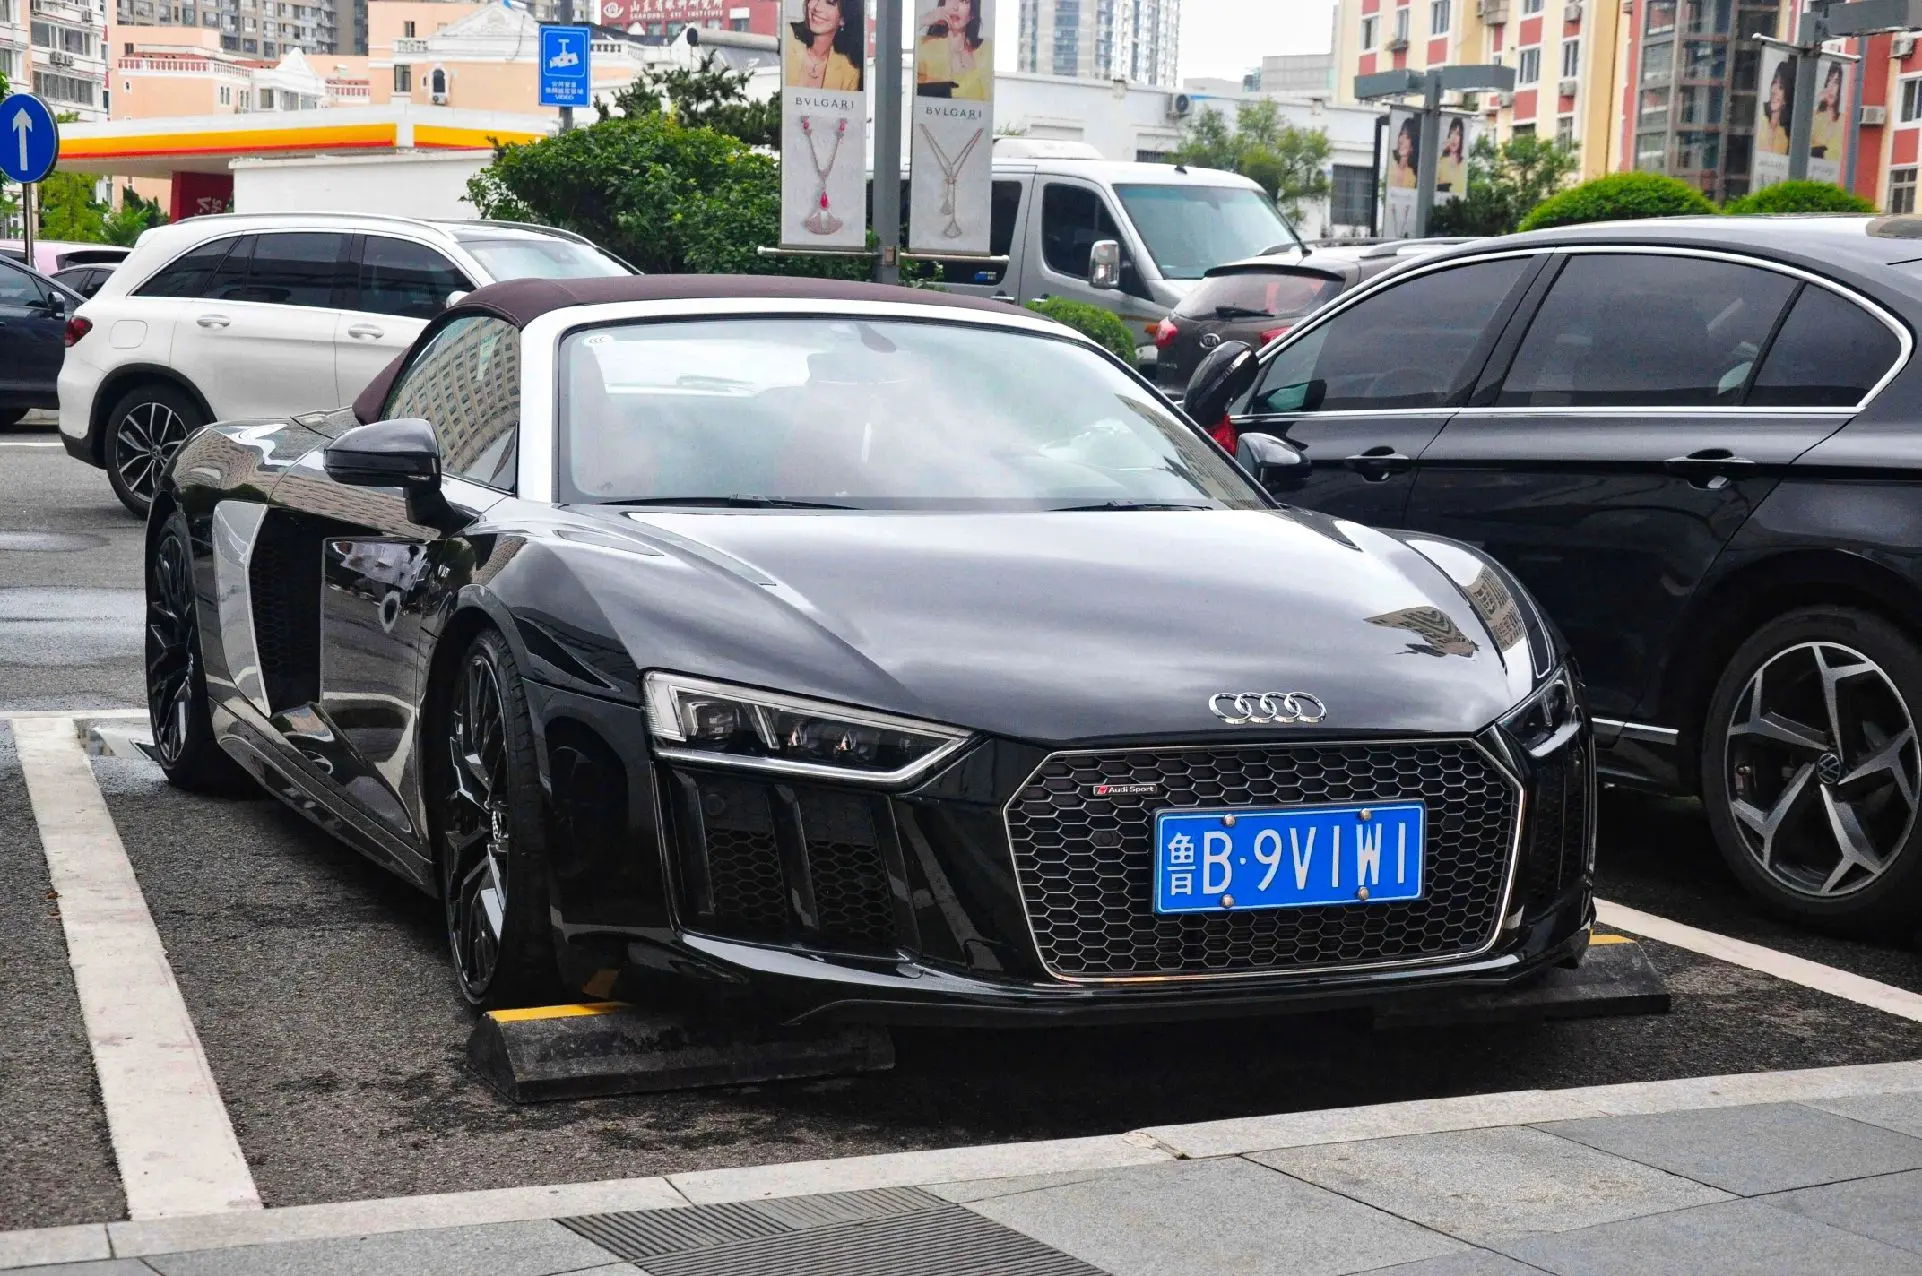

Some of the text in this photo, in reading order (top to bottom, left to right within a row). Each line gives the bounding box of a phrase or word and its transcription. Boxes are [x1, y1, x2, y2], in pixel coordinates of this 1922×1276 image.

[795, 96, 854, 109] BVLGARI
[925, 106, 982, 118] BVLGARI
[1129, 785, 1155, 794] Sport
